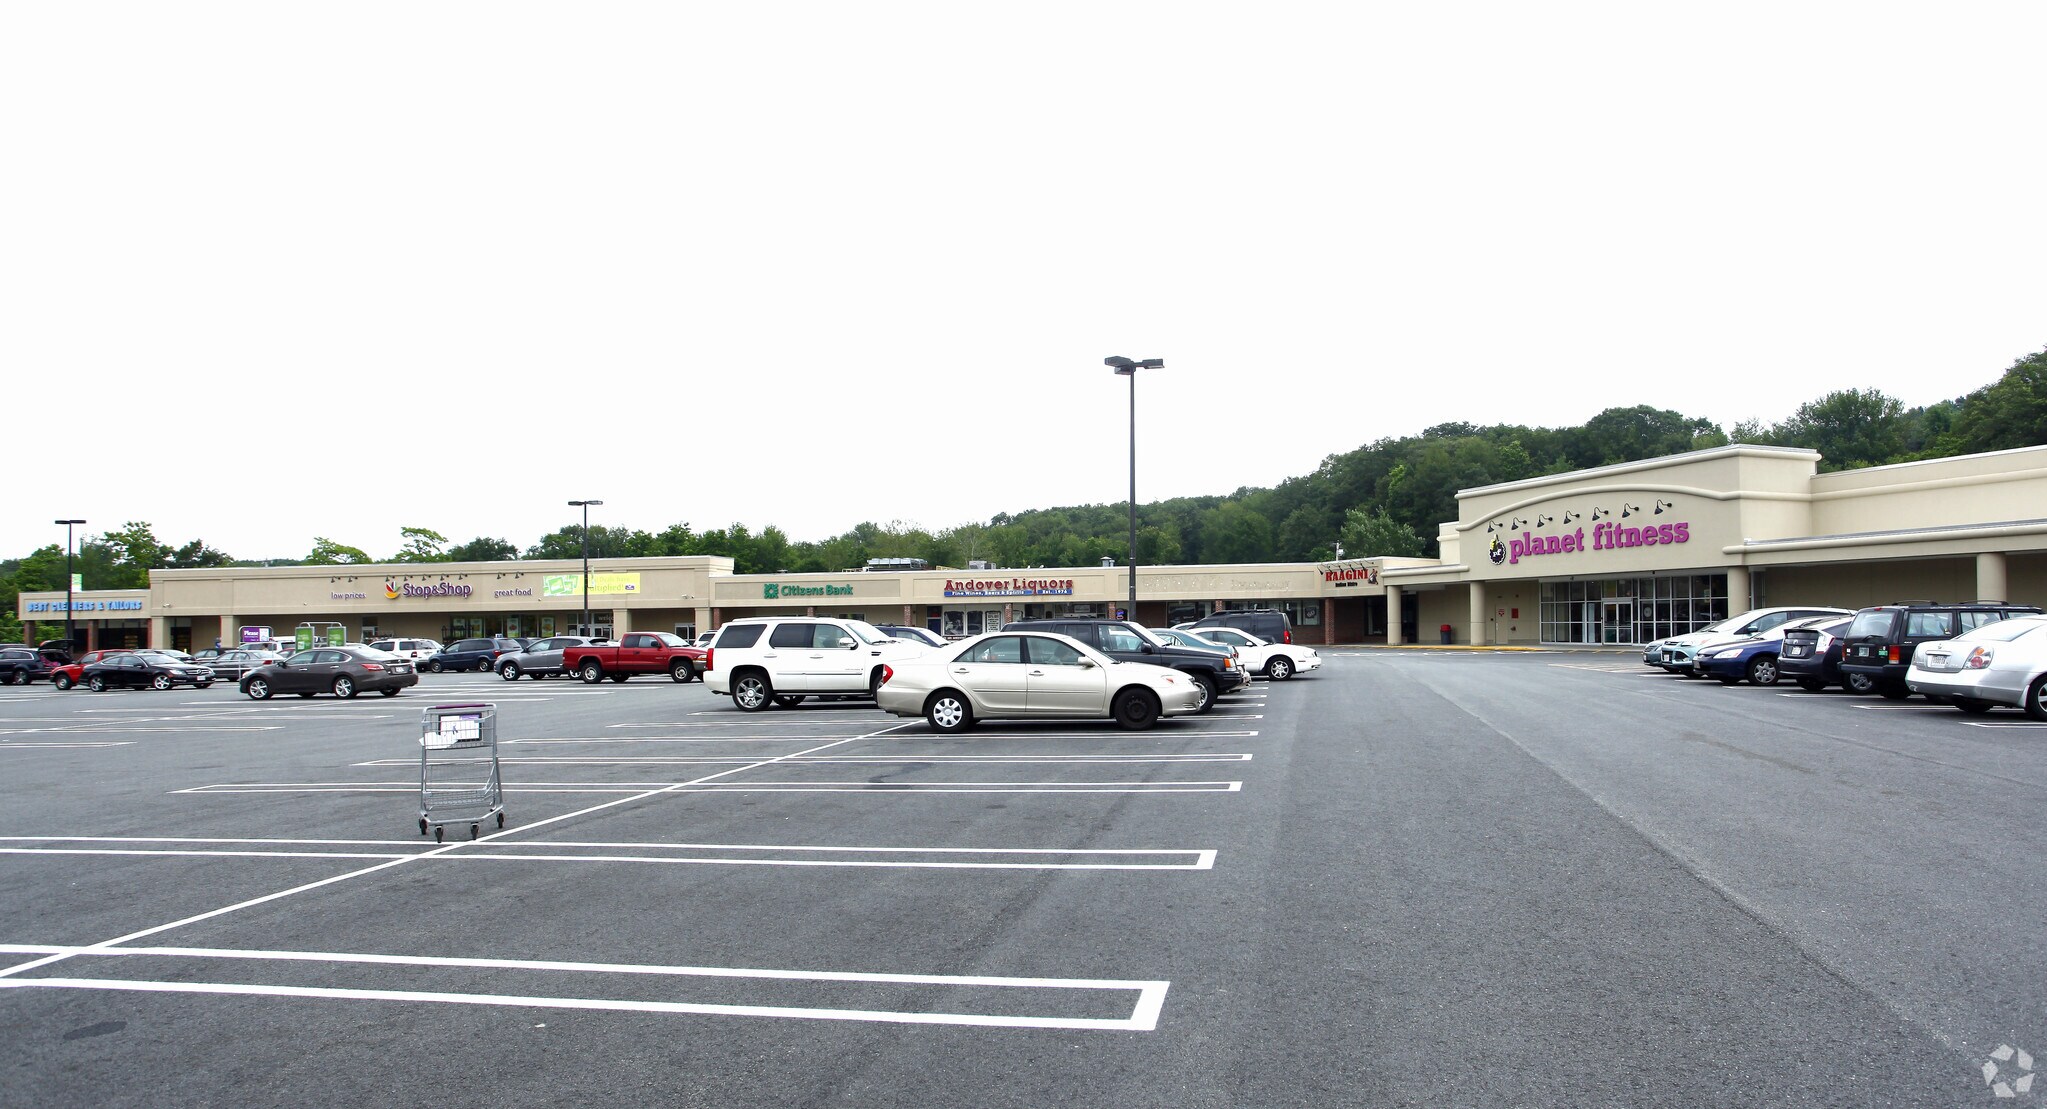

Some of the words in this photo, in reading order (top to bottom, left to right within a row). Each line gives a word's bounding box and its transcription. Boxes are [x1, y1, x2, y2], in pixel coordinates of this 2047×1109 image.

[1509, 527, 1585, 564] planet
[1592, 521, 1690, 550] fitness
[1493, 549, 1501, 557] pf
[1326, 569, 1369, 581] RAAGINI
[403, 582, 473, 598] Stop&Shop
[494, 590, 513, 598] great
[515, 588, 532, 596] food
[781, 585, 824, 596] Citizens
[825, 584, 854, 596] Bank
[944, 580, 1010, 591] Andover
[1012, 579, 1073, 595] Liquors
[344, 592, 366, 600] prices
[28, 601, 49, 611] BEST
[52, 601, 95, 611] CLENERS
[107, 600, 142, 610] TAILORS
